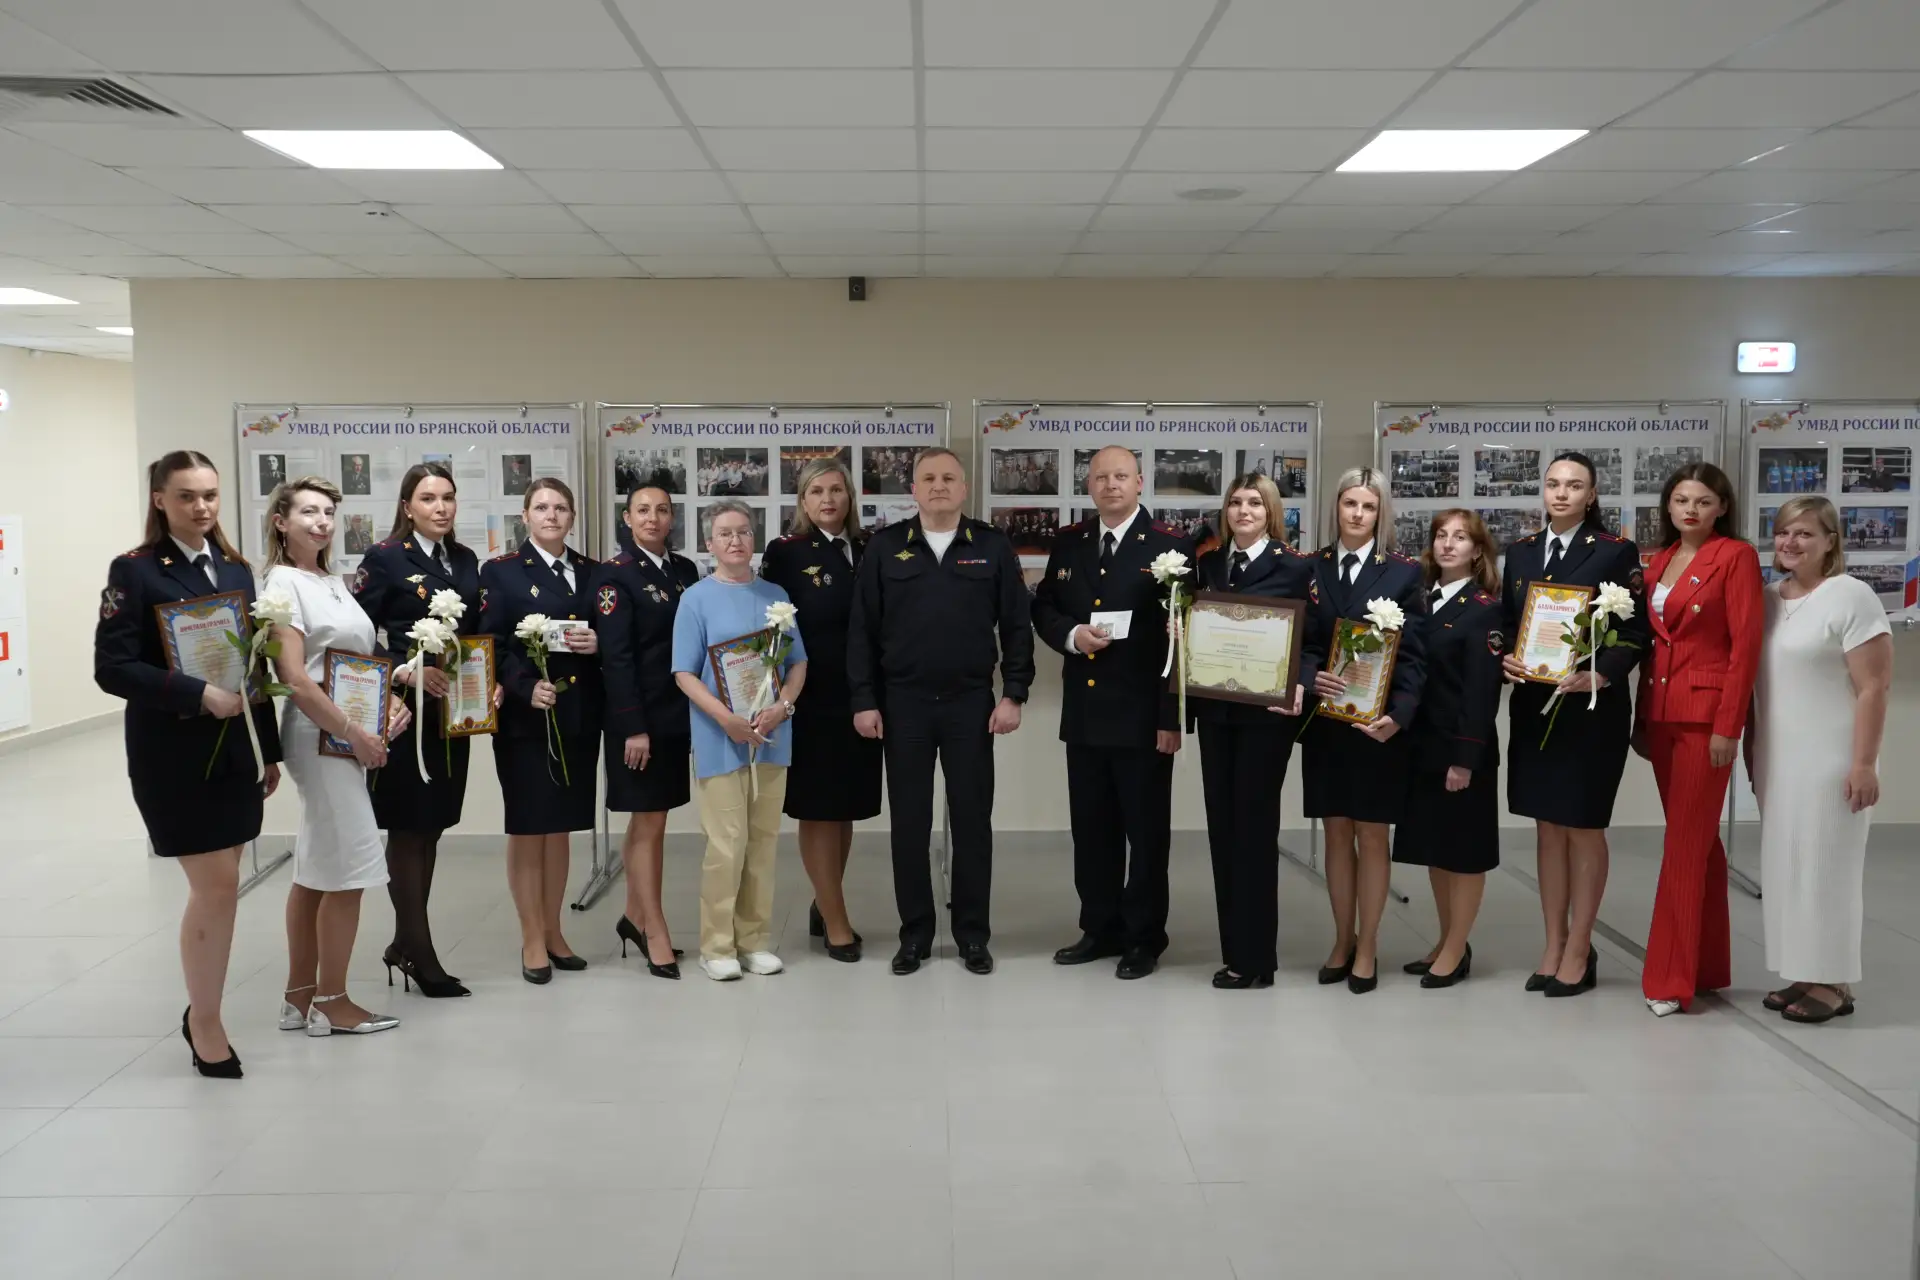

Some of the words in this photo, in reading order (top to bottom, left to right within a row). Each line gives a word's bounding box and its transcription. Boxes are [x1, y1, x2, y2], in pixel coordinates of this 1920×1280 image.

[287, 422, 329, 436] УМВД
[334, 422, 391, 435] РОССИИ
[395, 422, 414, 434] ПО
[420, 419, 498, 434] БРЯНСКОЙ
[502, 421, 571, 434] ОБЛАСТИ
[651, 423, 693, 437] УМВД
[698, 423, 755, 435] РОССИИ
[760, 423, 779, 434] ПО
[784, 419, 862, 435] БРЯНСКОЙ
[866, 422, 935, 435] ОБЛАСТИ
[1029, 420, 1070, 433] УМВД
[1075, 420, 1131, 432] РОССИИ
[1136, 420, 1155, 432] ПО
[1160, 416, 1237, 433] БРЯНСКОЙ
[1241, 420, 1308, 433] ОБЛАСТИ
[1428, 422, 1470, 436] УМВД
[1474, 421, 1531, 434] РОССИИ
[1536, 421, 1555, 433] ПО
[1560, 417, 1637, 433] БРЯНСКОЙ
[1641, 420, 1709, 432] ОБЛАСТИ
[1797, 419, 1839, 433] УМВД
[1843, 418, 1900, 431] РОССИИ
